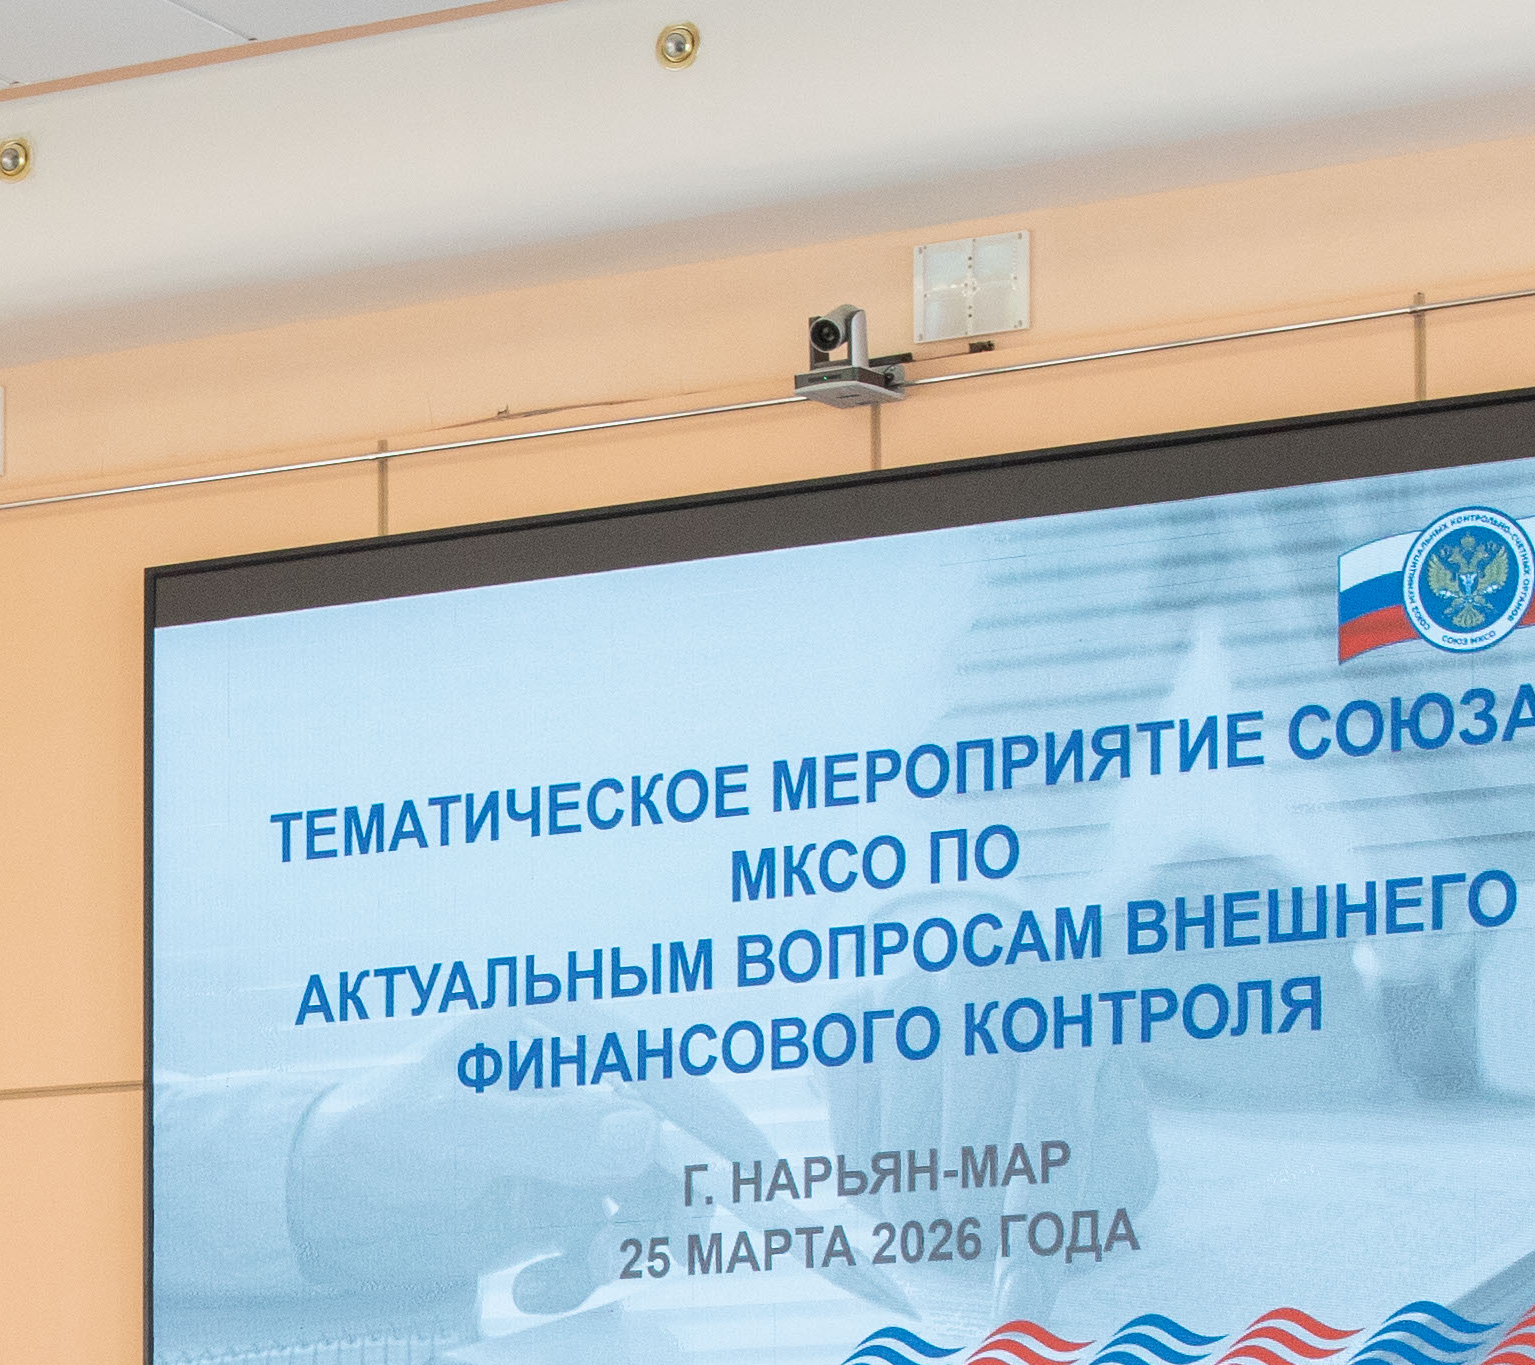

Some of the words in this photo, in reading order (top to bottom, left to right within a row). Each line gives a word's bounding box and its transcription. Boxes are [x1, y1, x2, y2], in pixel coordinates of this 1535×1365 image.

[1412, 605, 1430, 631] СОЮЗ
[1441, 635, 1469, 645] СОЮЗ
[270, 764, 750, 874] ТЕМАТИЧЕСКОЕ
[773, 704, 1265, 812] МЕРОПРИЯТИЕ
[732, 834, 907, 902] МКСО
[930, 824, 1020, 884] ПО
[295, 938, 713, 1026] АКТУАЛЬНЫМ
[737, 899, 1102, 987] ВОПРОСАМ
[1127, 869, 1518, 955] ВНЕШНЕГО
[457, 1005, 941, 1093] ФИНАНСОВОГО
[965, 975, 1322, 1056] КОНТРОЛЯ
[685, 1164, 716, 1207] Г.
[733, 1141, 1070, 1203] НАРЬЯН-МАР
[621, 1237, 670, 1278] 25
[688, 1225, 857, 1275] МАРТА
[872, 1217, 981, 1265] 2026
[1002, 1209, 1140, 1262] ГОДА
